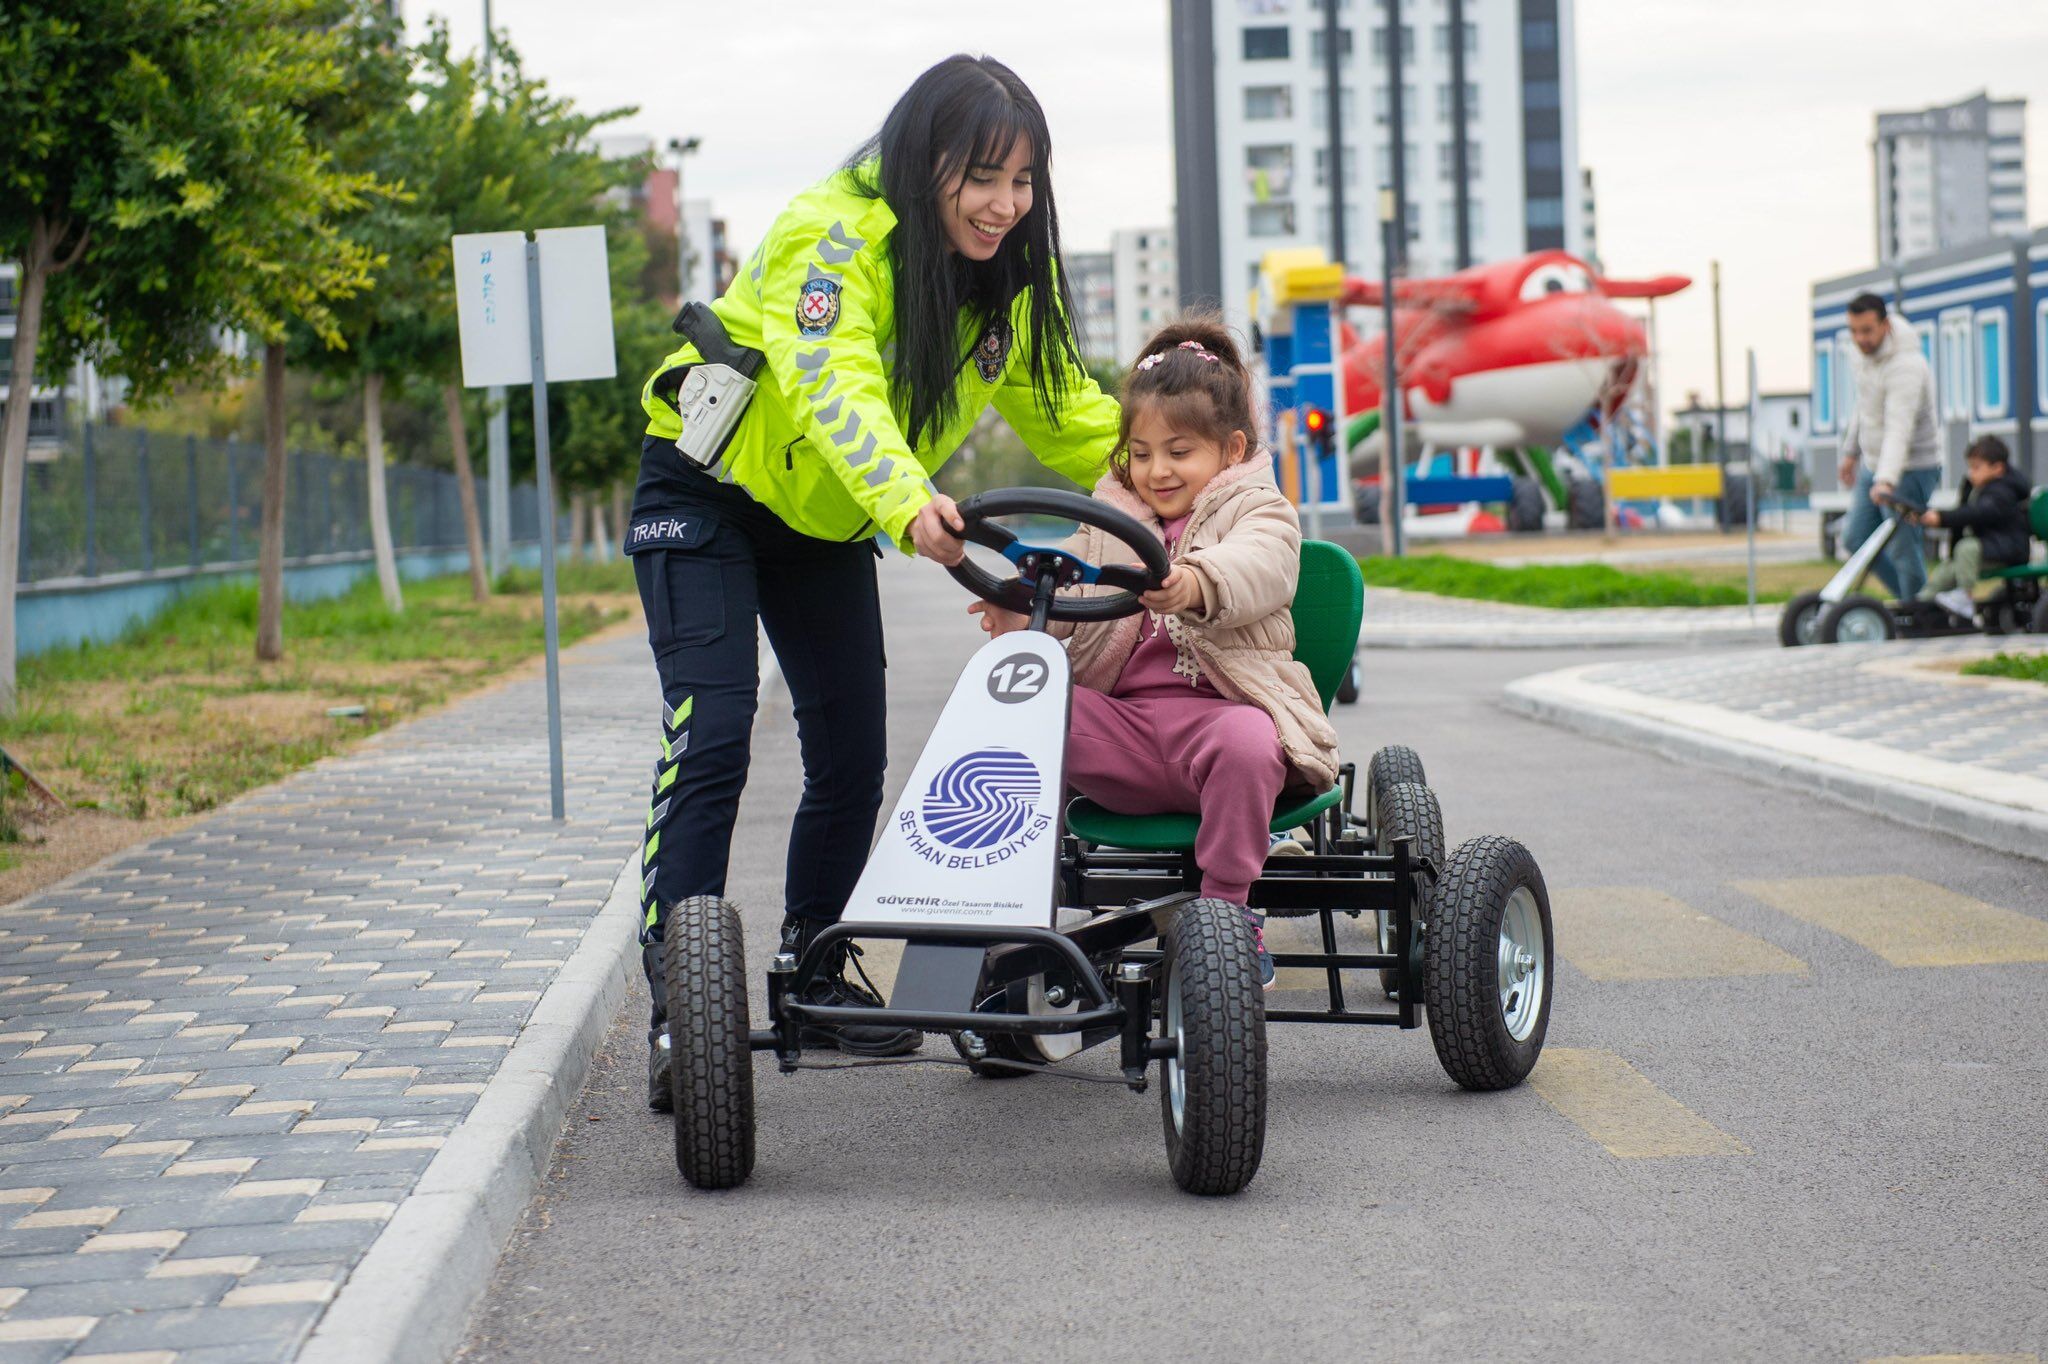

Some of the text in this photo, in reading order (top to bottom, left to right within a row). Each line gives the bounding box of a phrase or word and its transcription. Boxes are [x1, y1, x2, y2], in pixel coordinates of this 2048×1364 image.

[633, 518, 688, 543] TRAFİK
[992, 663, 1043, 692] 12
[900, 810, 1052, 869] SEYHAN BELEDİYESİ
[877, 895, 940, 906] GÜVENİR
[941, 899, 960, 907] Özel
[992, 901, 1024, 910] Bisiklet
